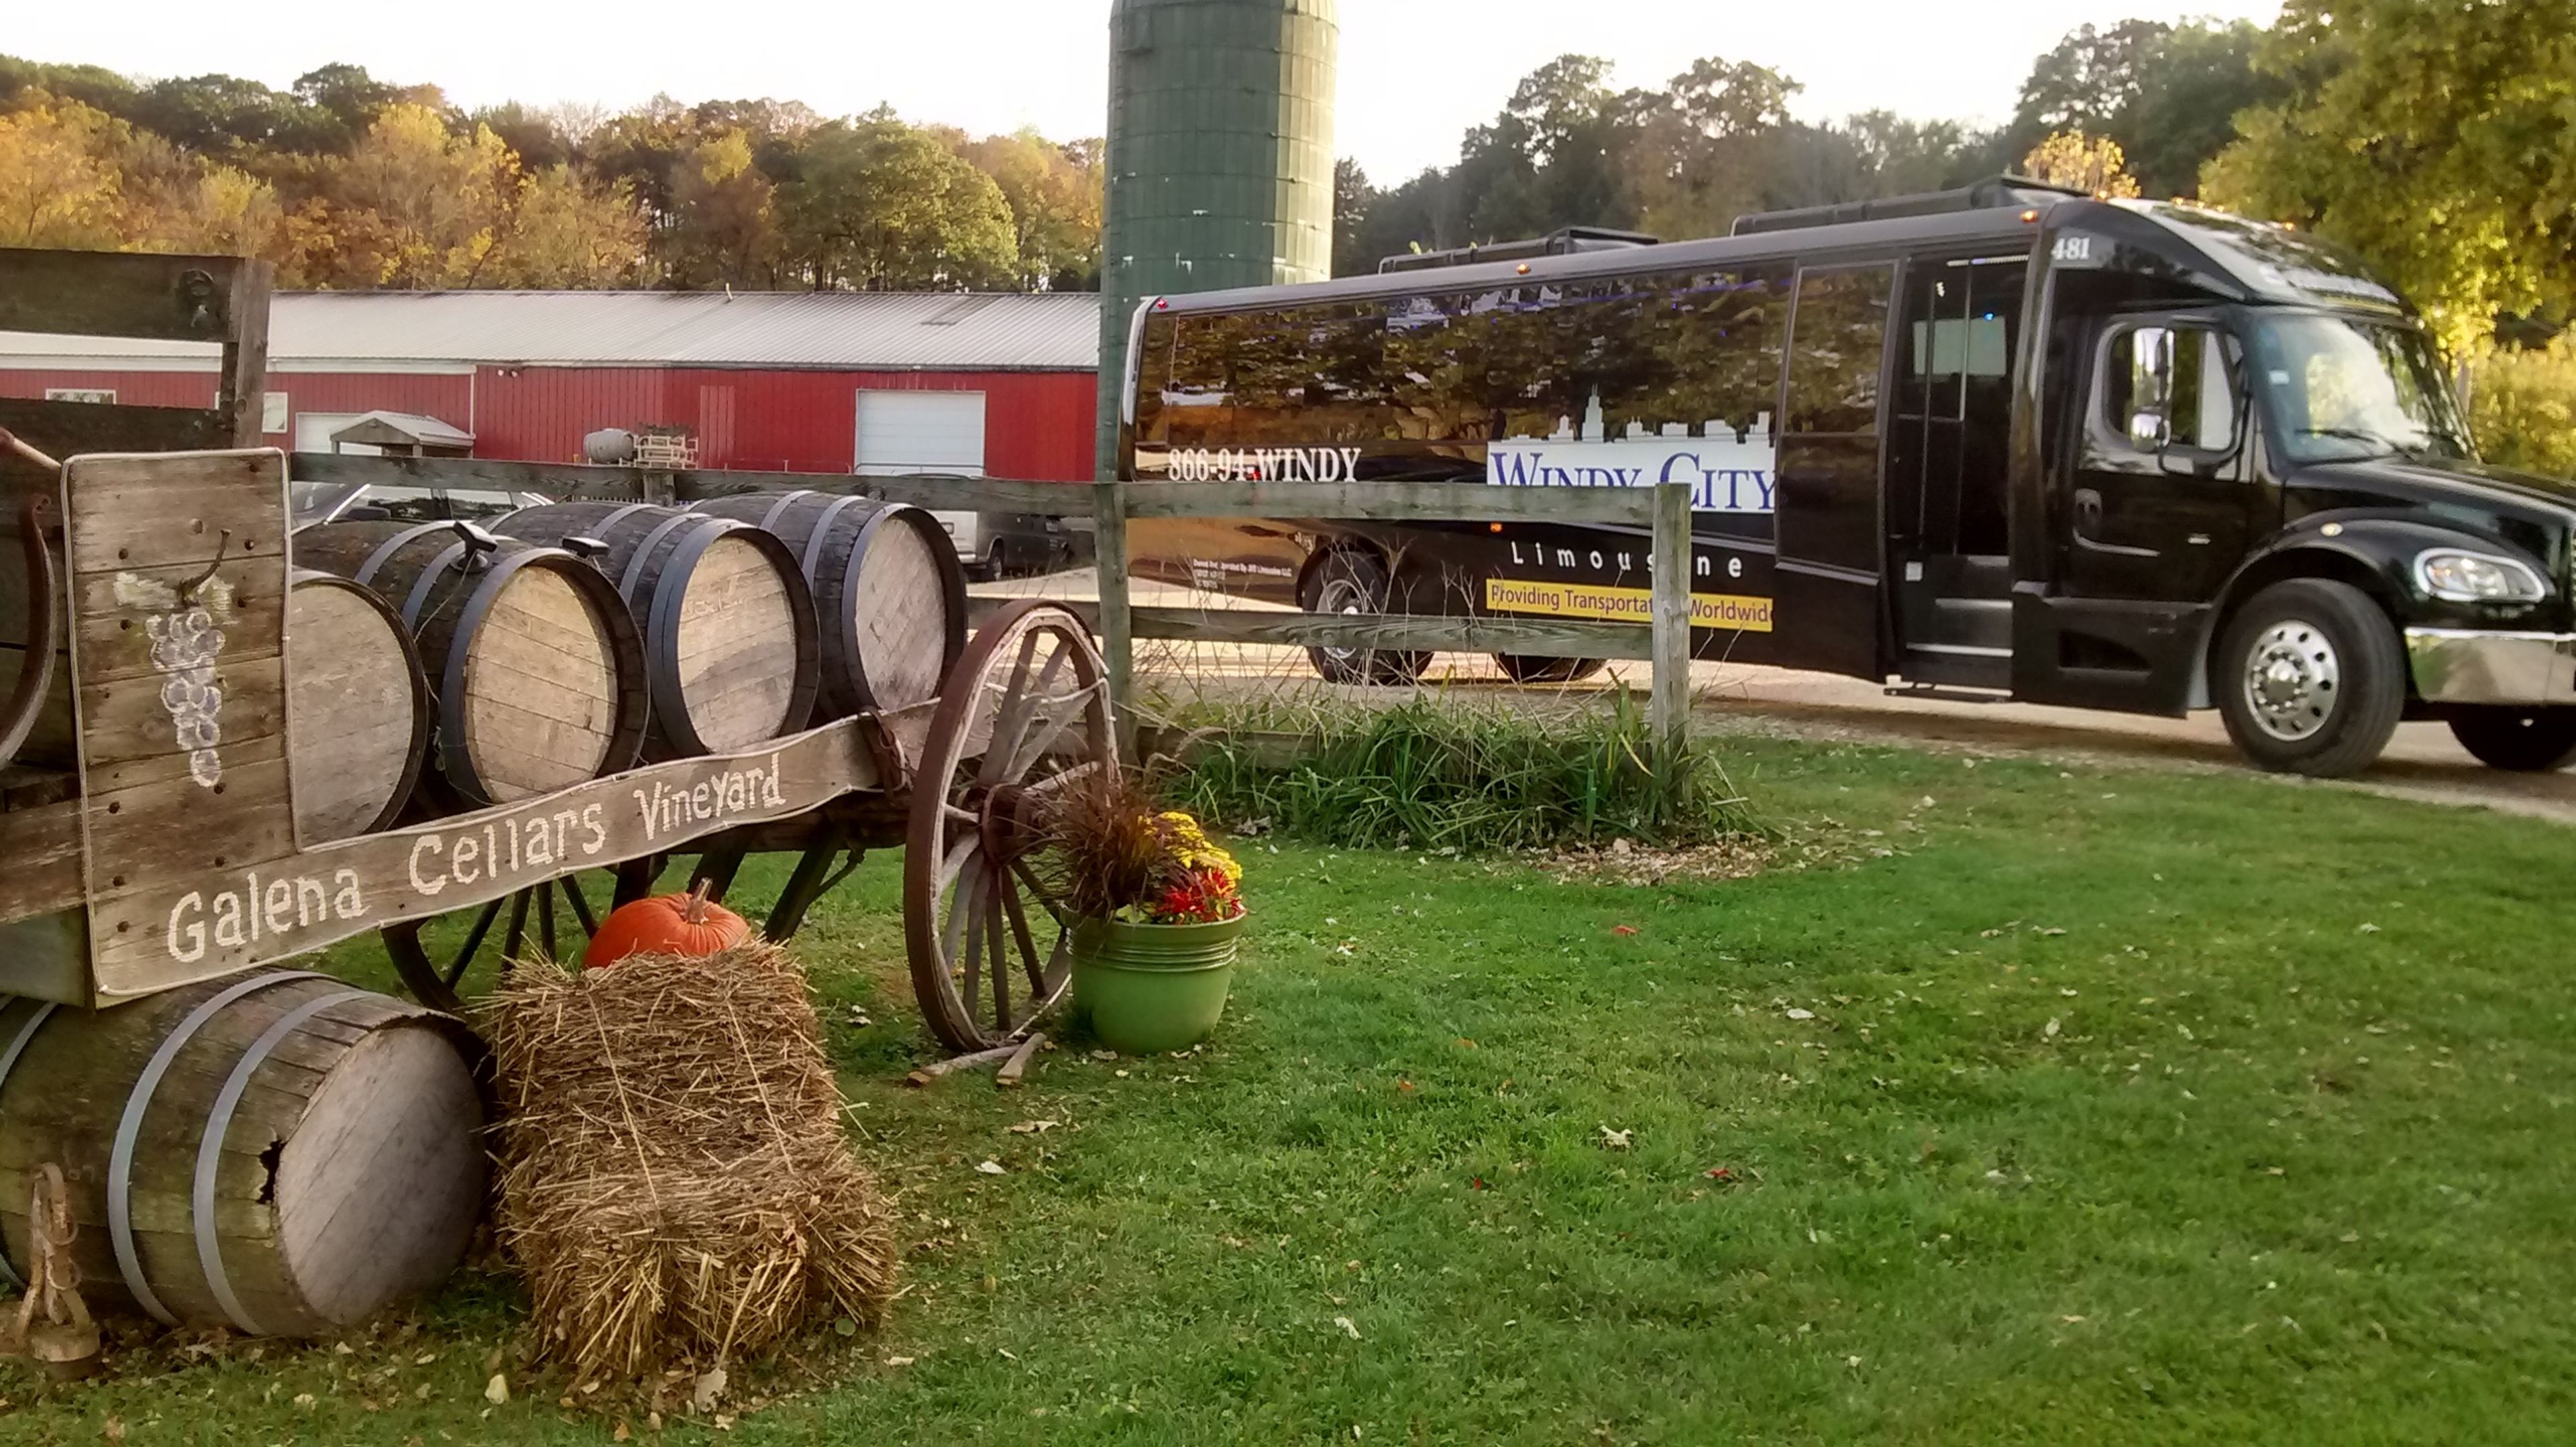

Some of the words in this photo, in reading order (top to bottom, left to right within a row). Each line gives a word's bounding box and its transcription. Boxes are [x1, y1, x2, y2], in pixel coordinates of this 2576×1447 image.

[2050, 237, 2090, 260] 481
[1168, 447, 1362, 483] 866-94-WINDY
[1660, 452, 1775, 510] CITY
[1511, 541, 1742, 578] Limousne
[1491, 584, 1560, 611] Providing
[1564, 590, 1653, 614] Transportat
[1690, 598, 1772, 623] Worldwid
[167, 868, 371, 963] Galena
[409, 802, 606, 895] Cellars
[633, 752, 786, 841] Vineyard
